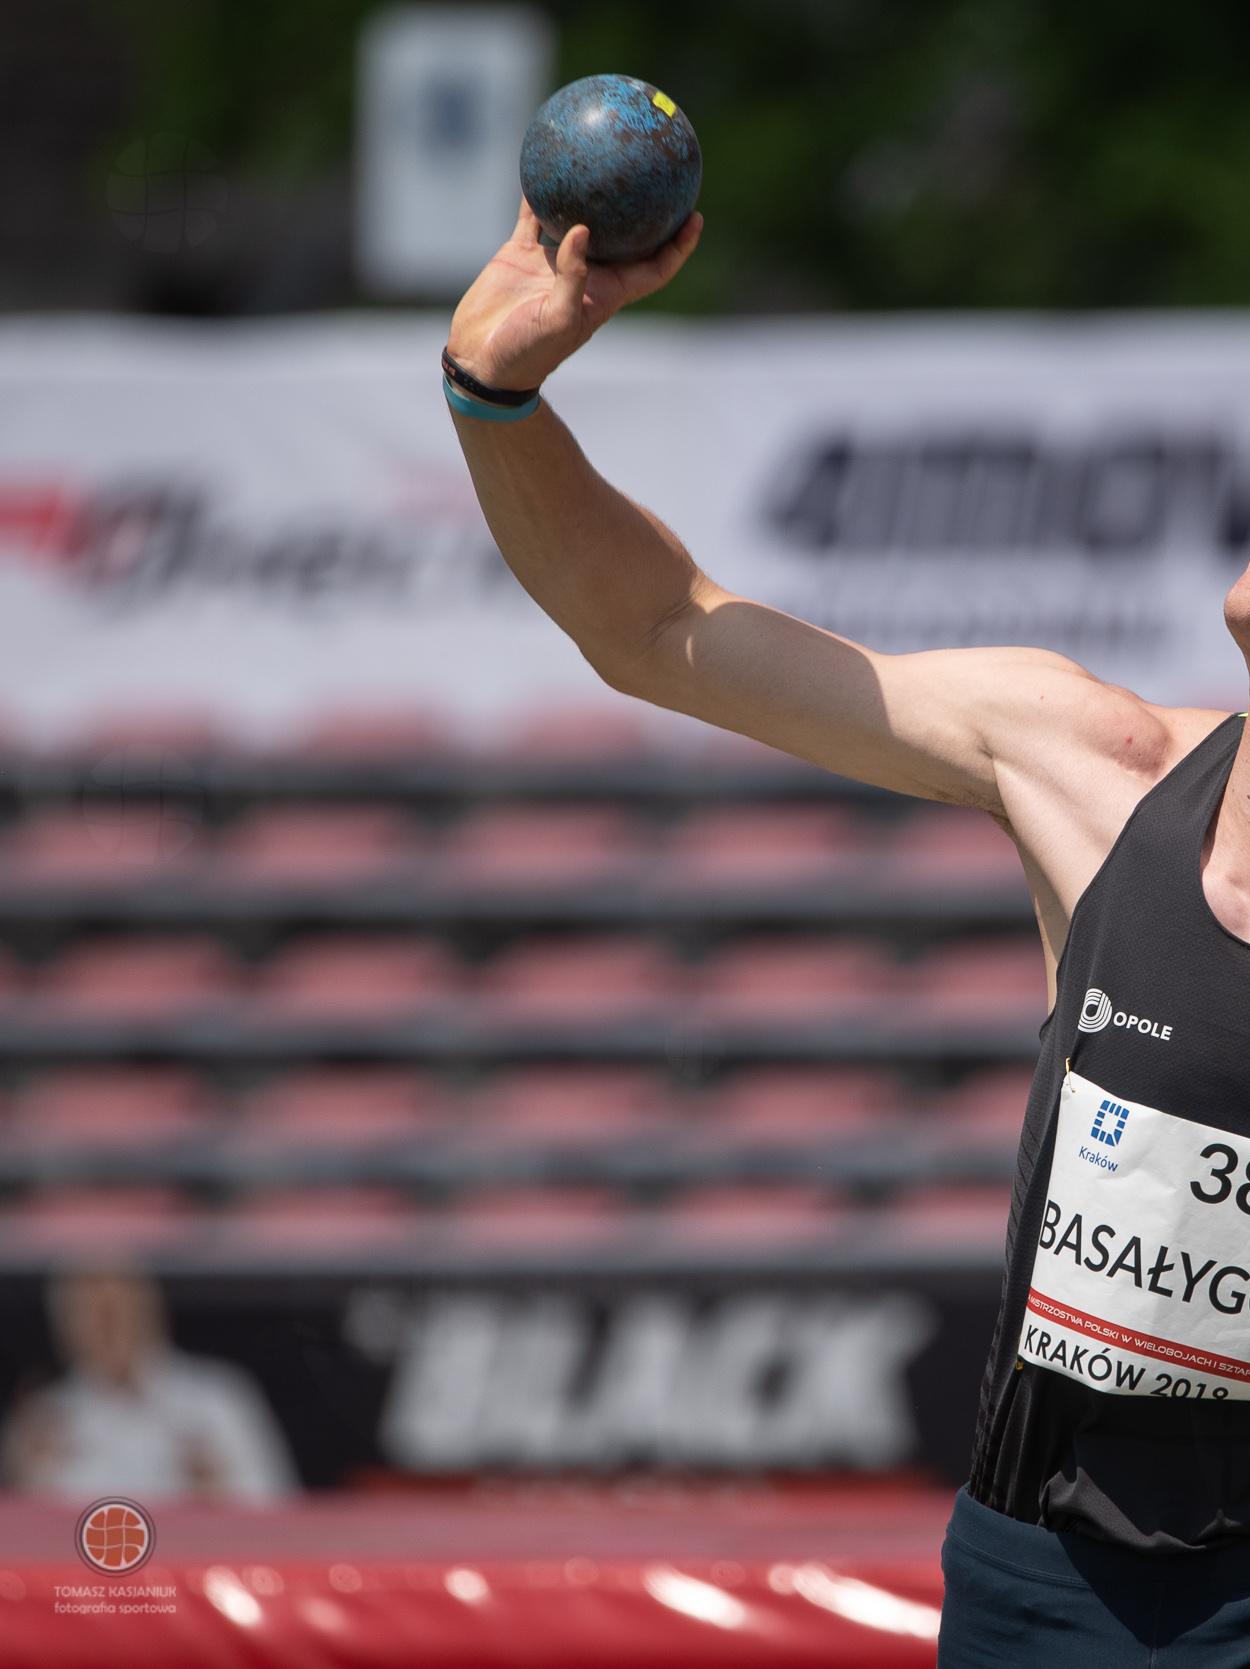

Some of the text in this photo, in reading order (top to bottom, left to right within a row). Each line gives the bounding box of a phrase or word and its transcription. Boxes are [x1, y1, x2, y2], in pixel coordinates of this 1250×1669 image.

[1112, 1010, 1174, 1041] OPOLE
[1078, 1146, 1119, 1173] Kraków
[1023, 1324, 1147, 1393] KRAKÓW
[1084, 1320, 1119, 1340] POLSKI
[1121, 1333, 1133, 1344] W
[1134, 1338, 1213, 1367] WIELOBOJACH
[380, 1290, 934, 1469] BLACK
